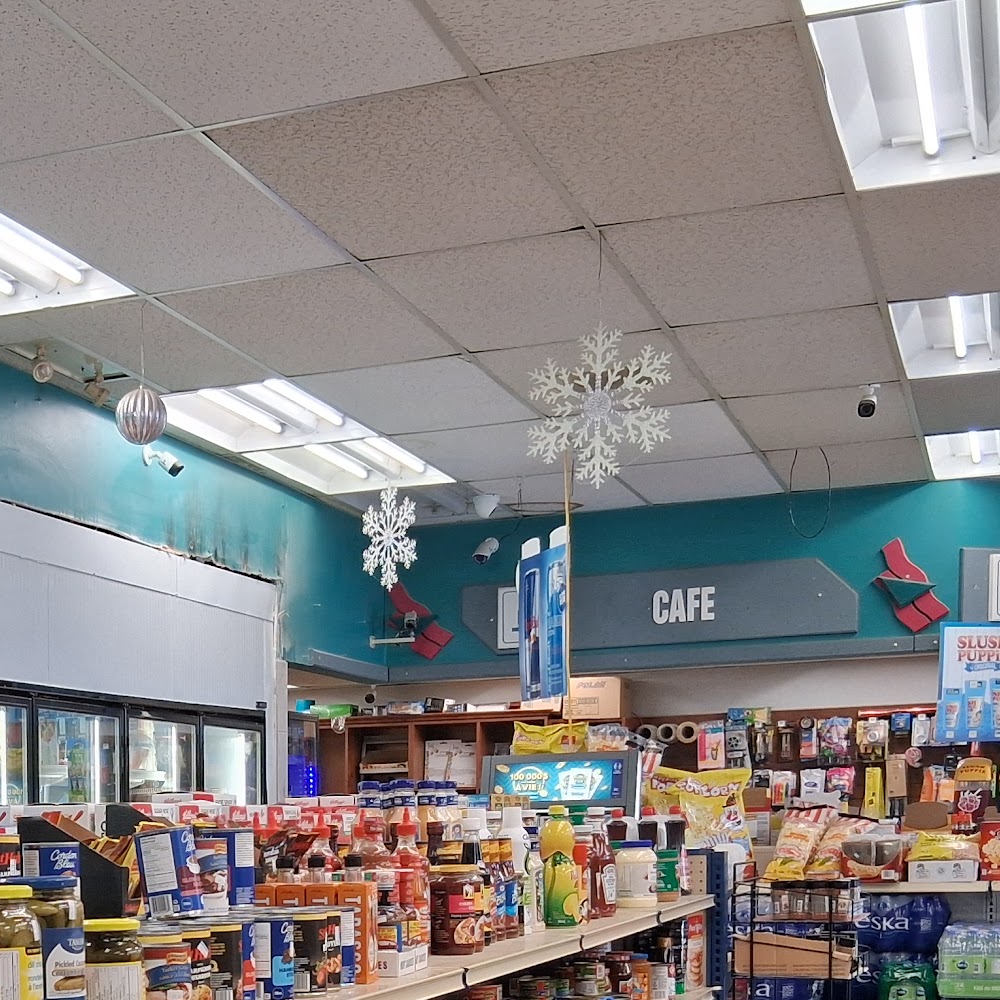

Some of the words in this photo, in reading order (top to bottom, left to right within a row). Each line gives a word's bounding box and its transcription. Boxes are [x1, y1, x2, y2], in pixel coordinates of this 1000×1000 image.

[652, 586, 716, 625] CAFE
[957, 636, 1000, 649] SLUS
[510, 773, 524, 781] 100
